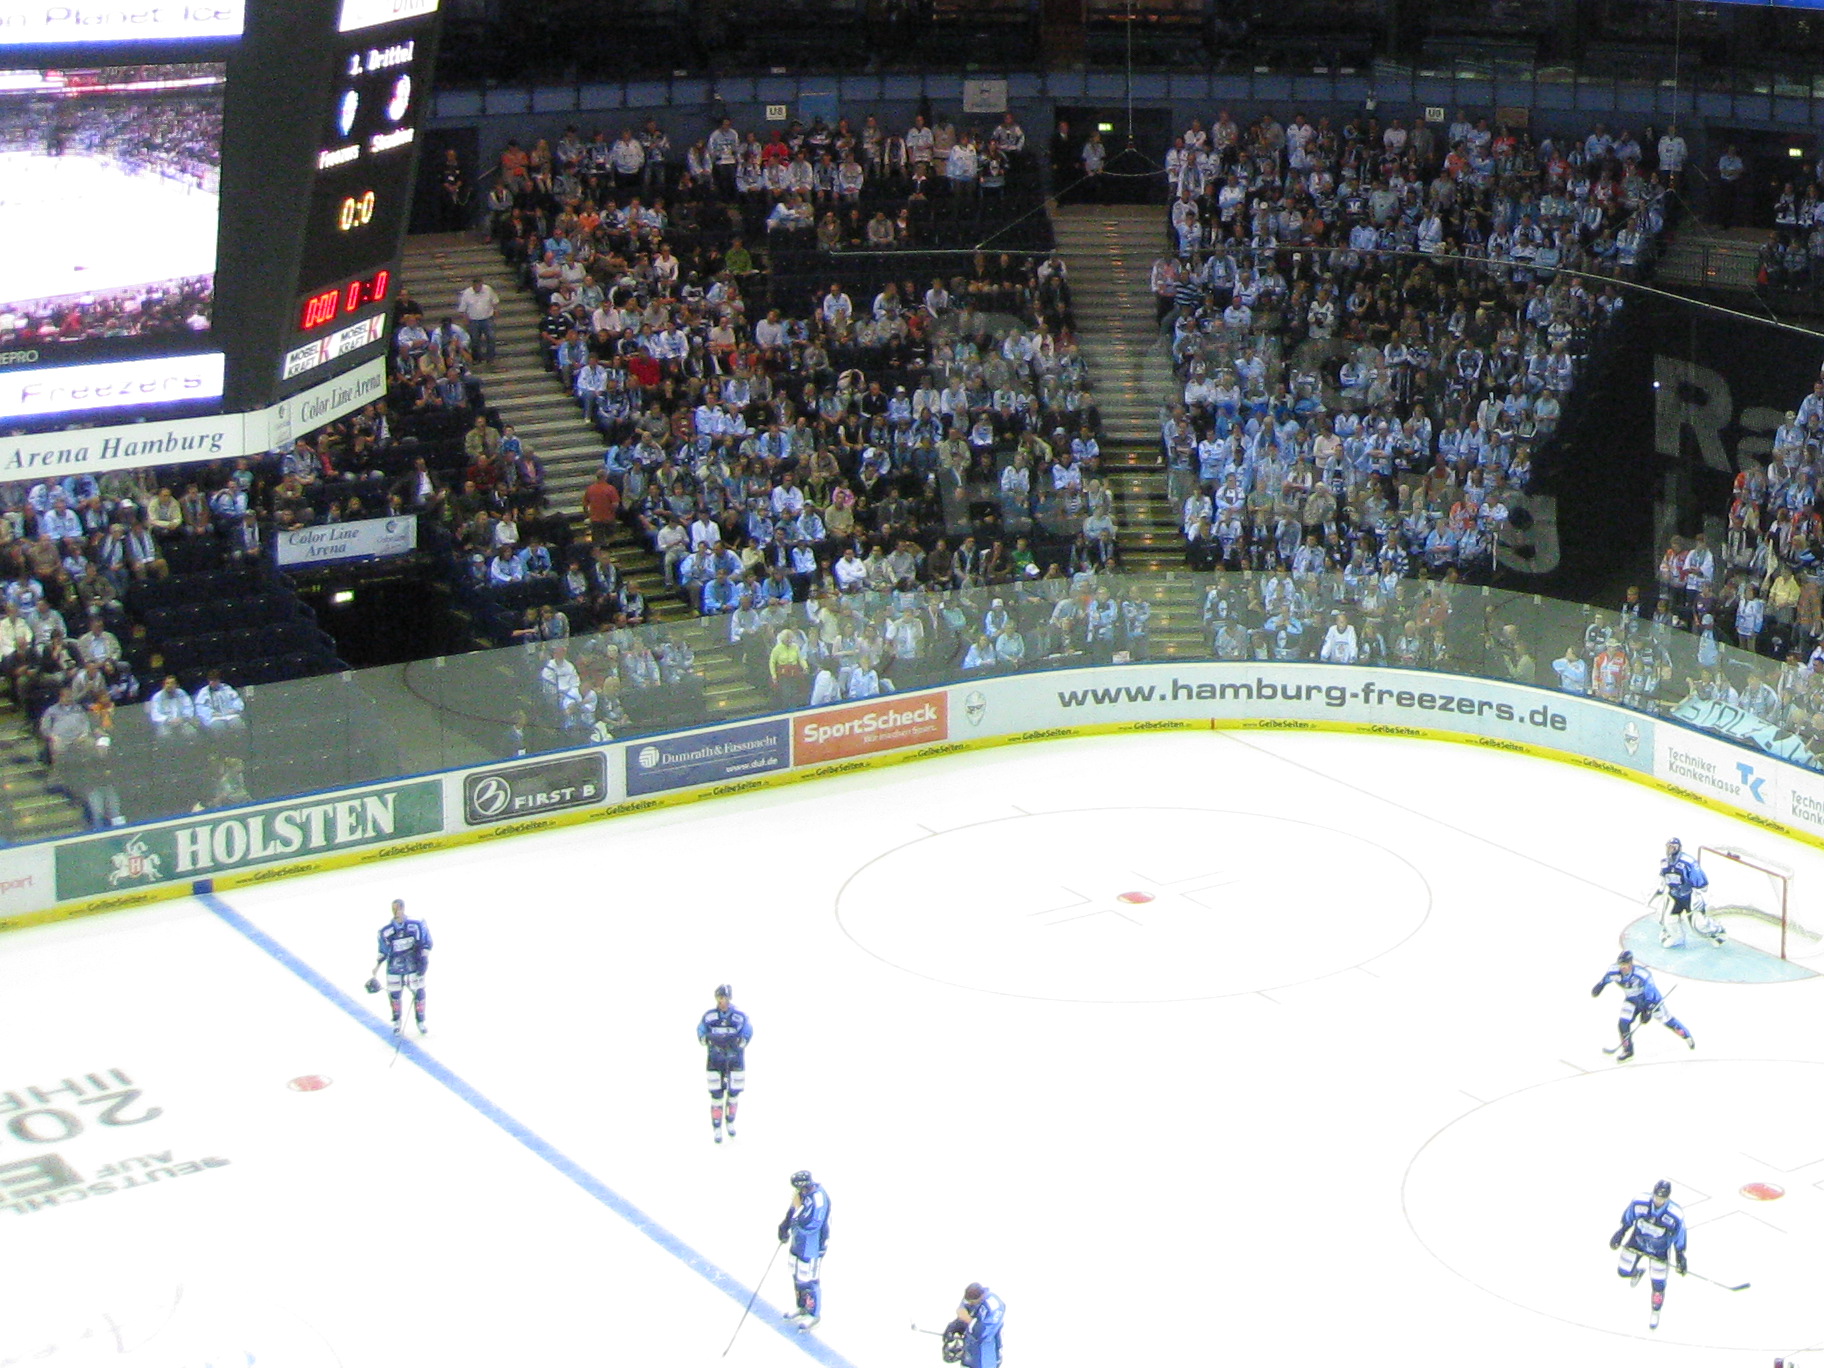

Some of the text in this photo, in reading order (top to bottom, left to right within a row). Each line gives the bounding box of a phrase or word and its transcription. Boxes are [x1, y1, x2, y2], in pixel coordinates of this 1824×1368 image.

[46, 6, 164, 27] Planet
[21, 374, 202, 404] Freezers
[301, 373, 381, 423] Color Line Arena
[4, 431, 225, 471] Arena Hamburg
[289, 526, 360, 546] Color Line
[305, 543, 347, 558] Arena
[1058, 677, 1568, 732] www.hamburg-freezers.de
[803, 701, 938, 743] SportScheck
[1668, 747, 1718, 775] Techniker
[1668, 760, 1741, 797] Krankenkasse
[513, 782, 597, 812] FIRST B
[175, 791, 399, 874] HOLSTEN
